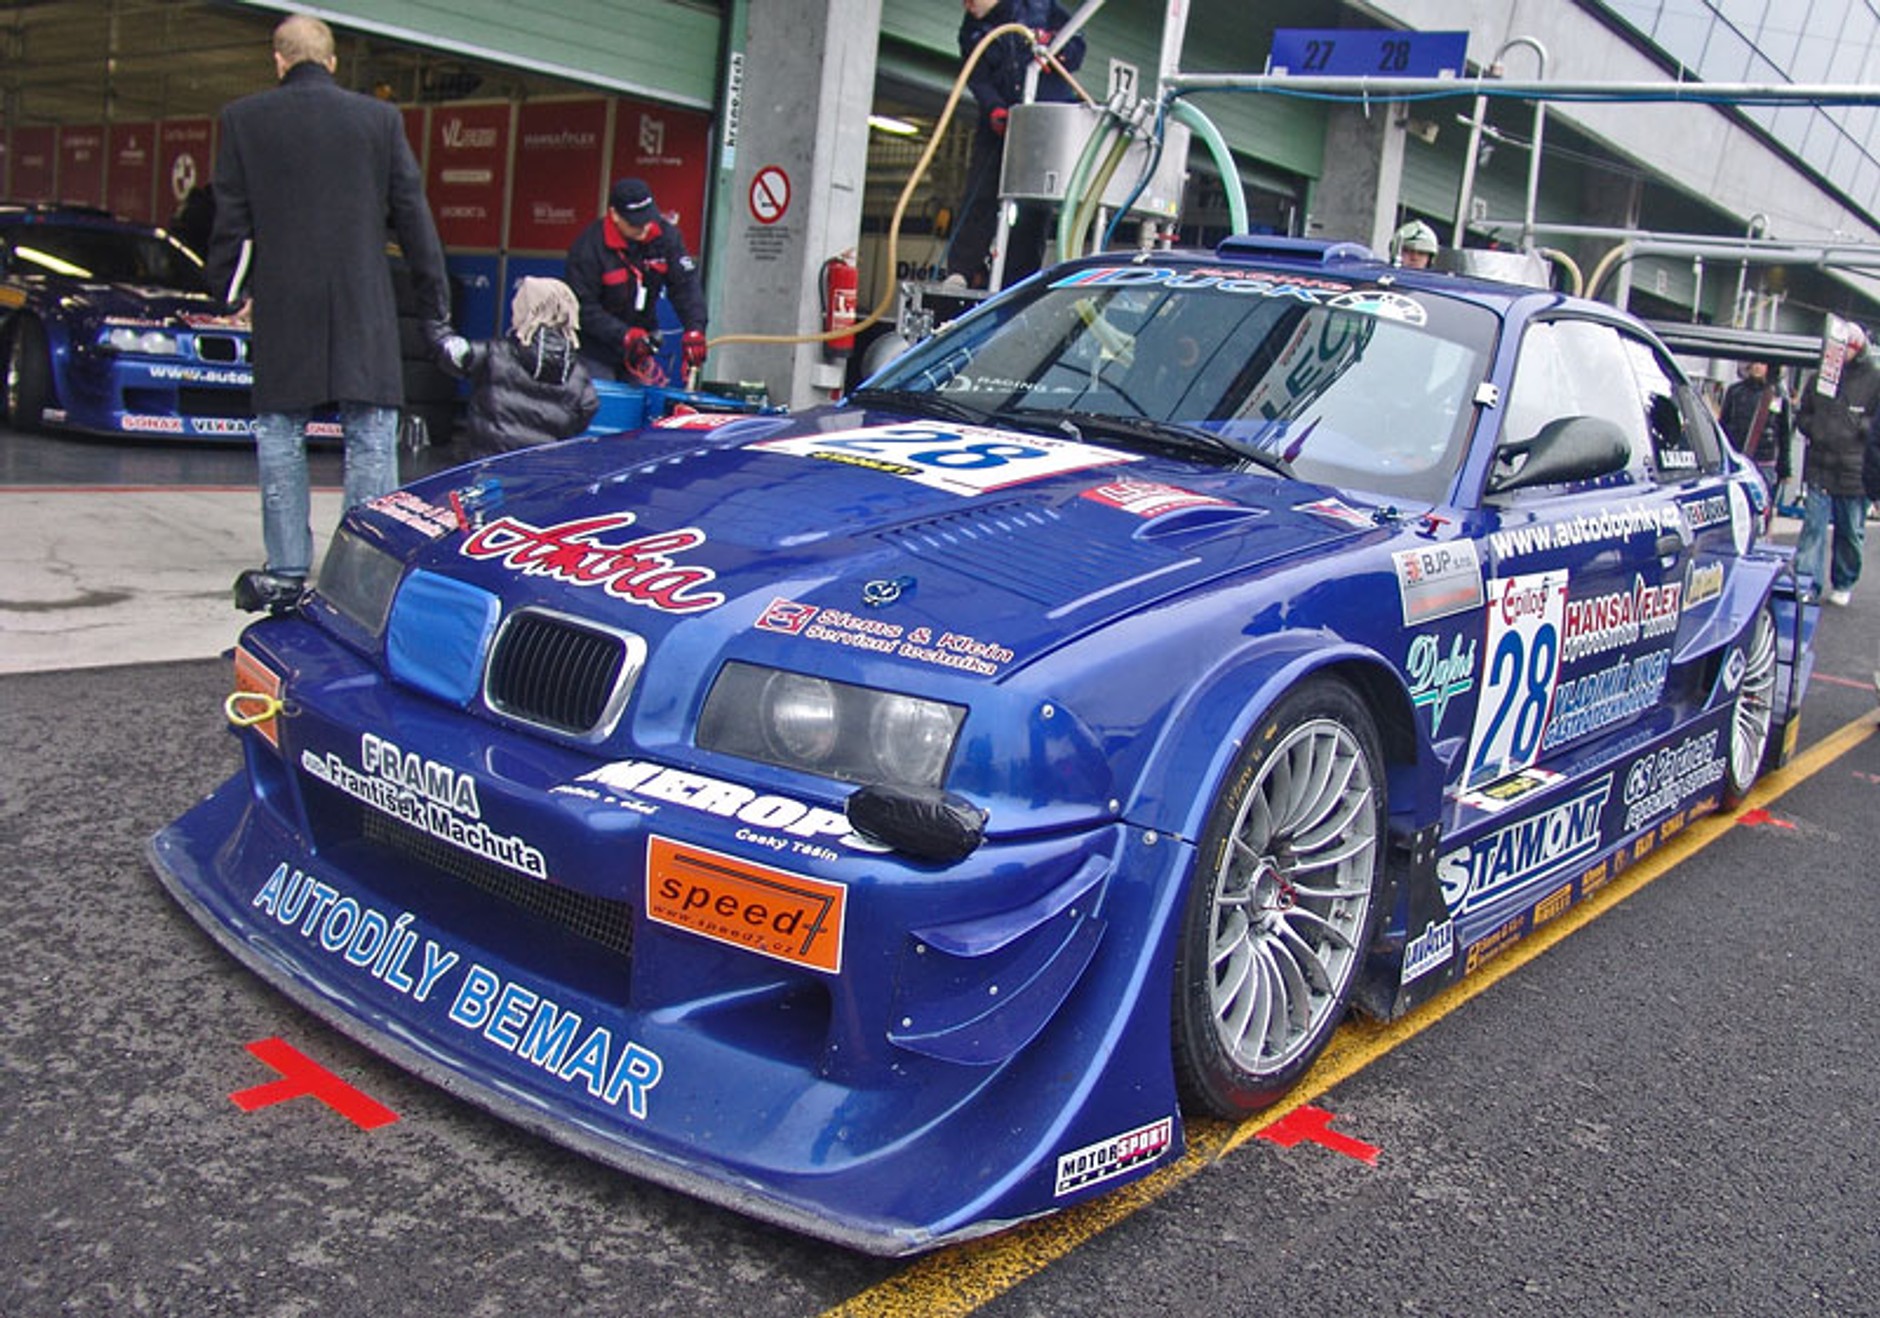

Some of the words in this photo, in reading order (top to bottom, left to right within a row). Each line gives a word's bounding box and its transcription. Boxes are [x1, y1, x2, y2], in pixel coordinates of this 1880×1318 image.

[1114, 65, 1134, 95] 17
[1303, 40, 1335, 71] 27
[1378, 40, 1411, 71] 28
[808, 429, 1049, 470] 28
[1421, 549, 1451, 575] BJP
[1565, 592, 1633, 639] HANSA
[1642, 583, 1680, 622] FLEX
[908, 627, 932, 644] &
[936, 632, 1014, 663] Klein
[1469, 623, 1557, 790] 28
[362, 733, 480, 818] FRAMA
[428, 800, 547, 879] Machuta
[1437, 783, 1608, 917] STAMONT
[253, 862, 459, 1002] AUTODÍLY
[448, 964, 663, 1120] BEMAR
[1061, 1122, 1169, 1179] MOTORSPORT
